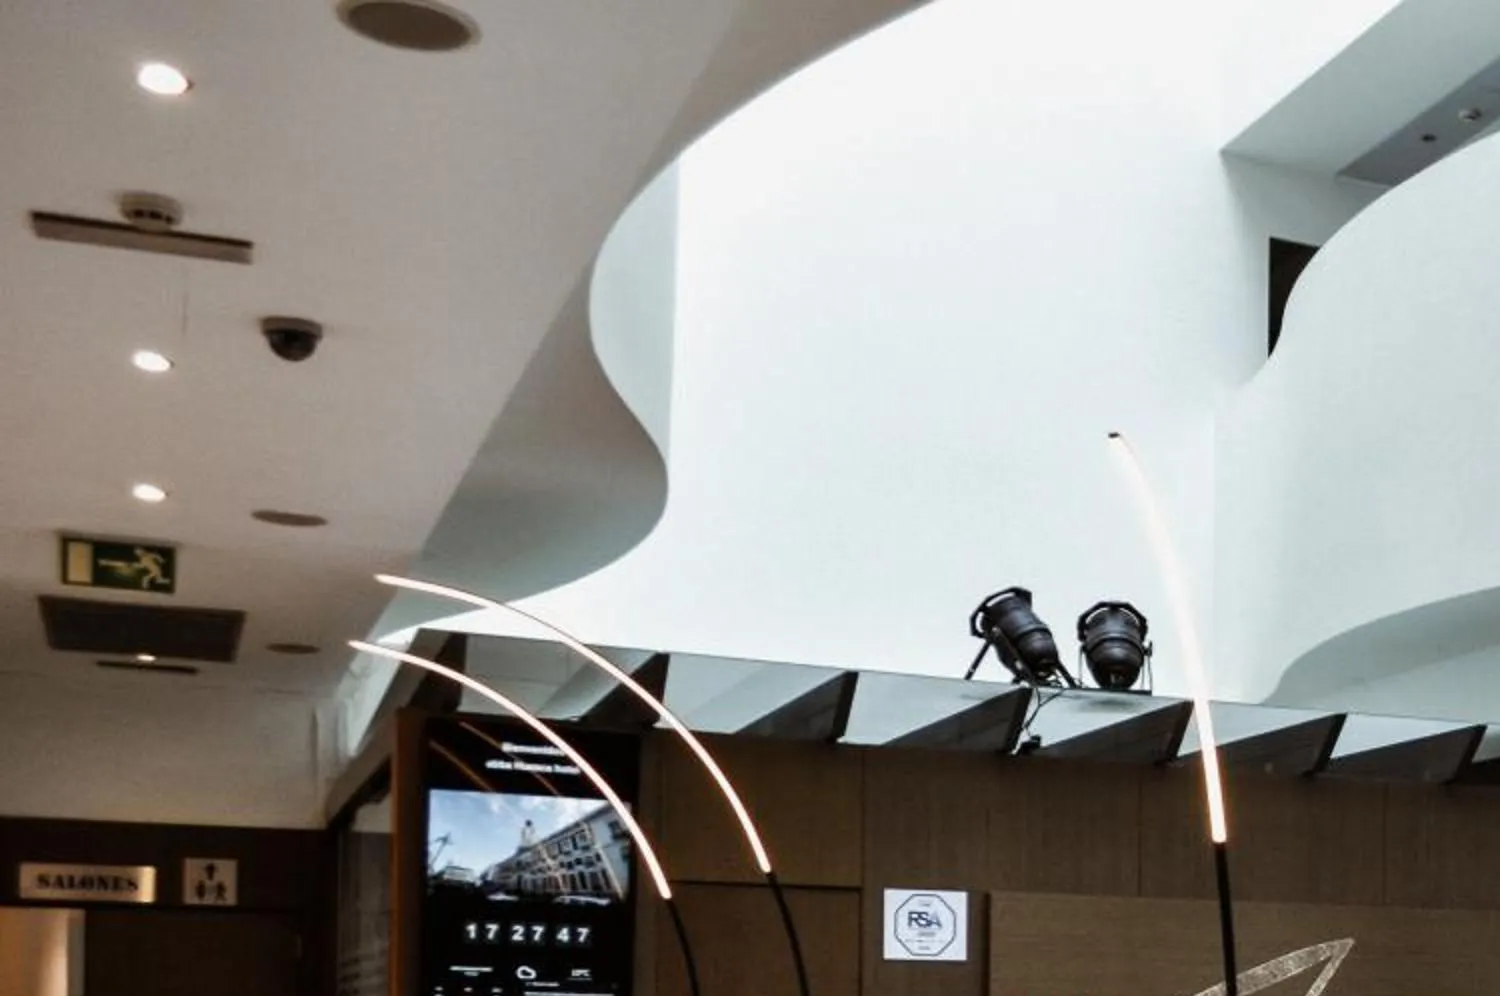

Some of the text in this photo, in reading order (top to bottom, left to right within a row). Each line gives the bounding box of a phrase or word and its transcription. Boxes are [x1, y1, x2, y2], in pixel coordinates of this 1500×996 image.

[36, 873, 139, 892] SALONES
[465, 923, 590, 943] 17 27 47
